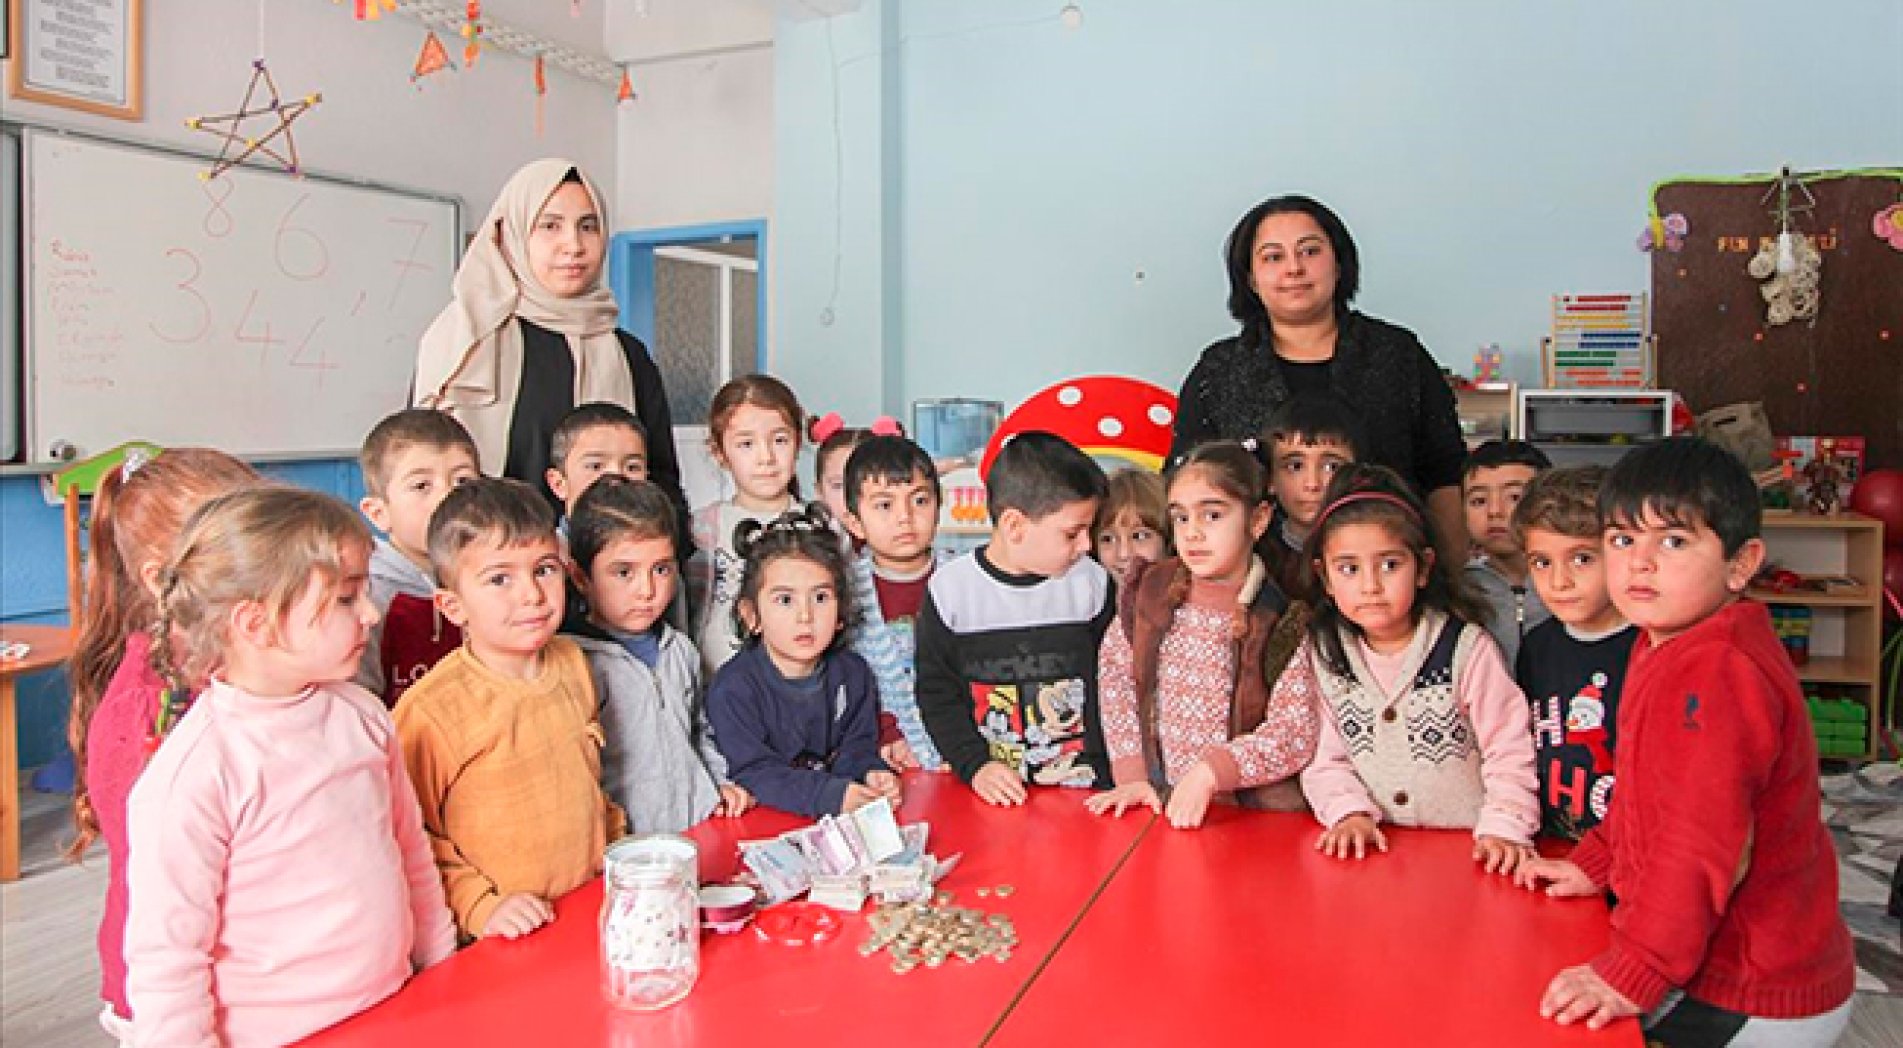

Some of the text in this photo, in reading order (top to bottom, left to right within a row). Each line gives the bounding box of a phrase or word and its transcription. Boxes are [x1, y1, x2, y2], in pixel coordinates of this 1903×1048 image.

[273, 192, 329, 281] 6
[388, 218, 435, 310] 7
[149, 247, 212, 344] 3
[234, 289, 285, 368] 4
[289, 316, 341, 390] 4
